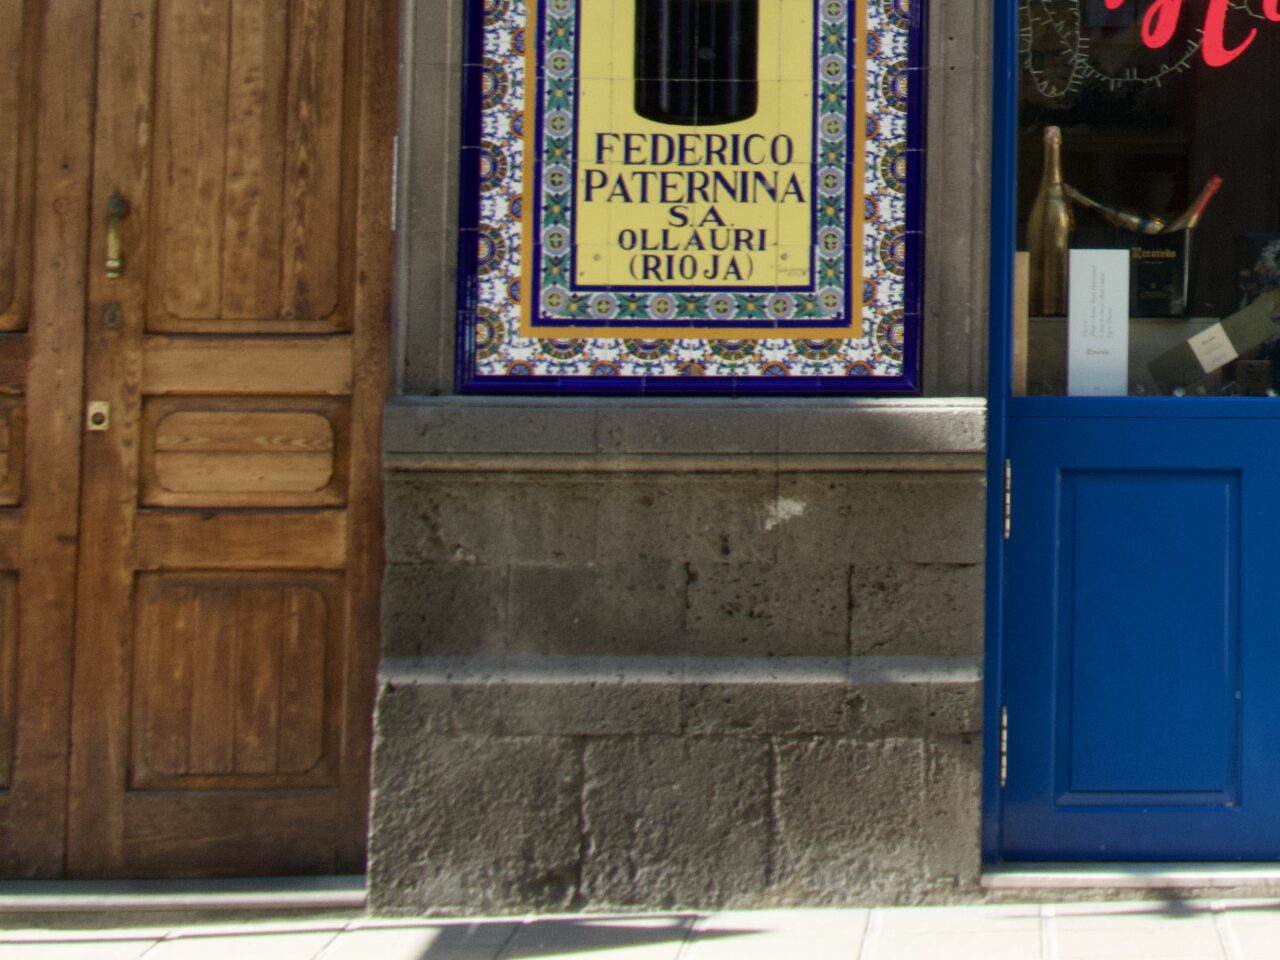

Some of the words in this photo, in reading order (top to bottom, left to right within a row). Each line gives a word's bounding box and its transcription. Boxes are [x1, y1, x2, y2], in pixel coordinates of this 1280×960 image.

[595, 133, 793, 166] FEDERICO
[583, 169, 806, 203] PATERNINA
[668, 205, 735, 227] S.A.
[618, 228, 767, 251] OLLAURI
[629, 254, 754, 282] (RIOJA)
